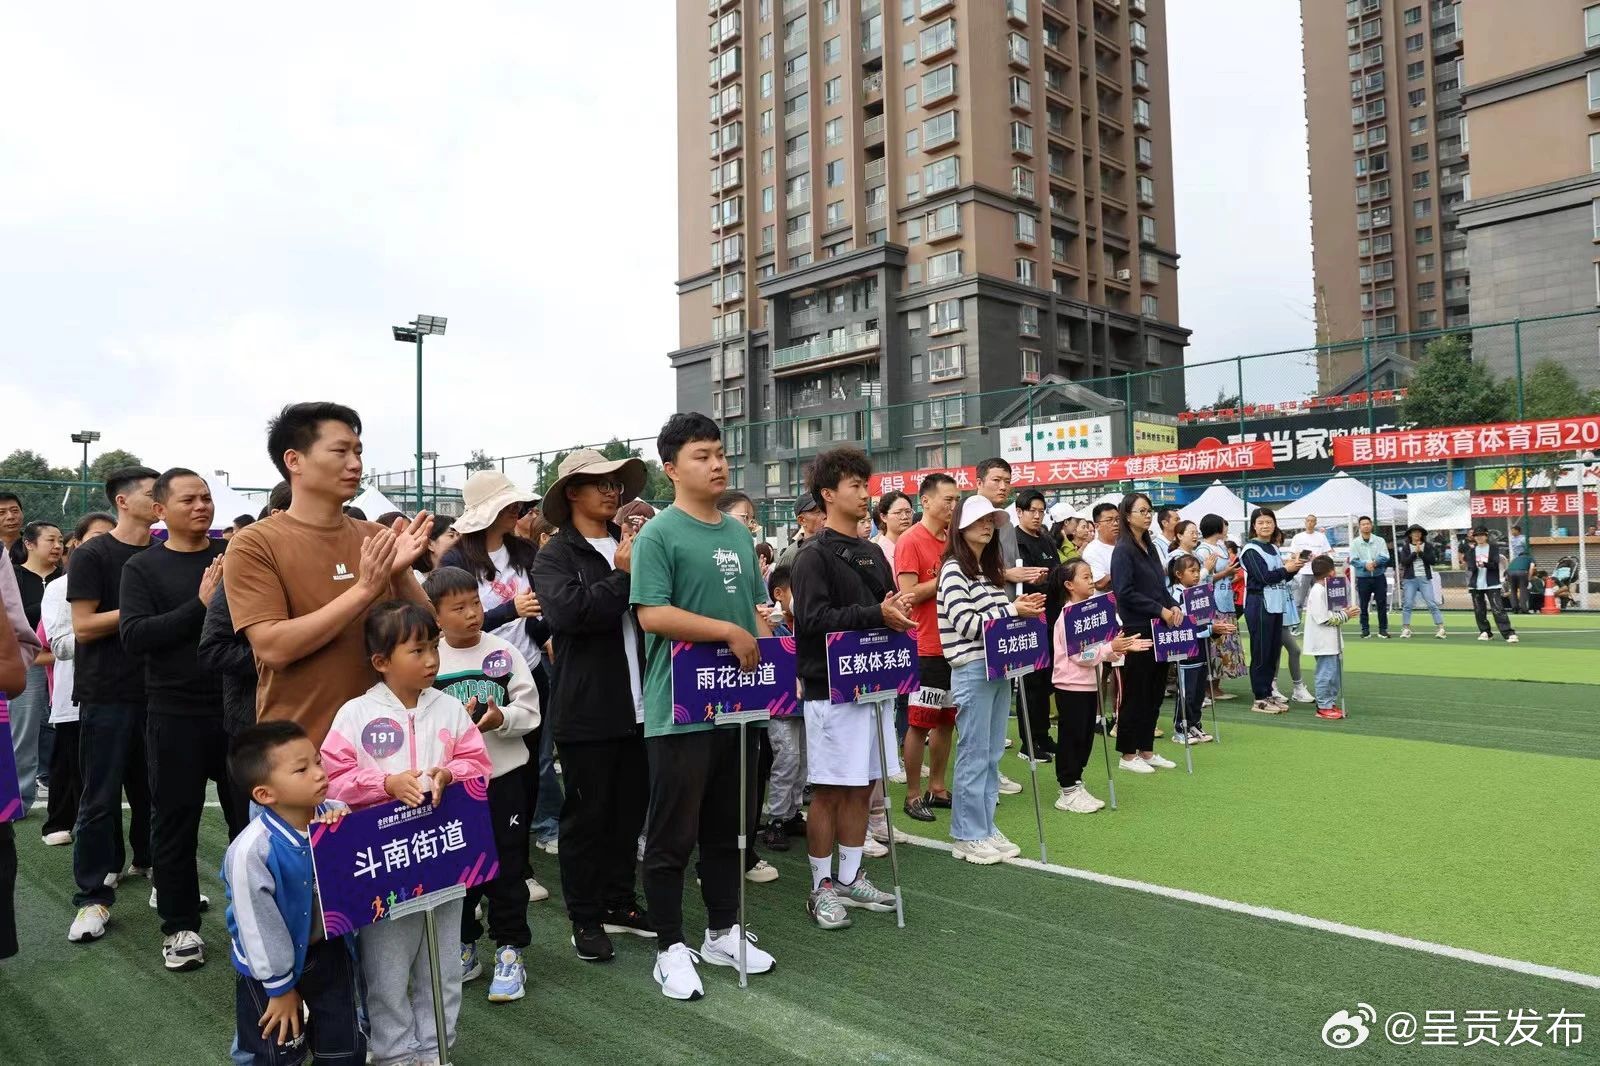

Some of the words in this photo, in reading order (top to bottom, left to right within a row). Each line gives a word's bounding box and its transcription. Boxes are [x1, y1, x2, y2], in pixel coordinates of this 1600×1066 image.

[1227, 427, 1329, 462] 当家
[1352, 421, 1599, 462] 昆明市教育体育局20
[1124, 445, 1254, 477] 健康运动新风尚
[1074, 609, 1108, 635] 洛龙街道
[1158, 628, 1194, 645] 吴家营街道
[997, 631, 1039, 655] 乌龙街道
[488, 659, 507, 668] 163
[696, 661, 776, 690] 雨花街道
[838, 647, 912, 676] 区教体系统
[370, 732, 395, 744] 191
[354, 819, 467, 879] 斗南街道
